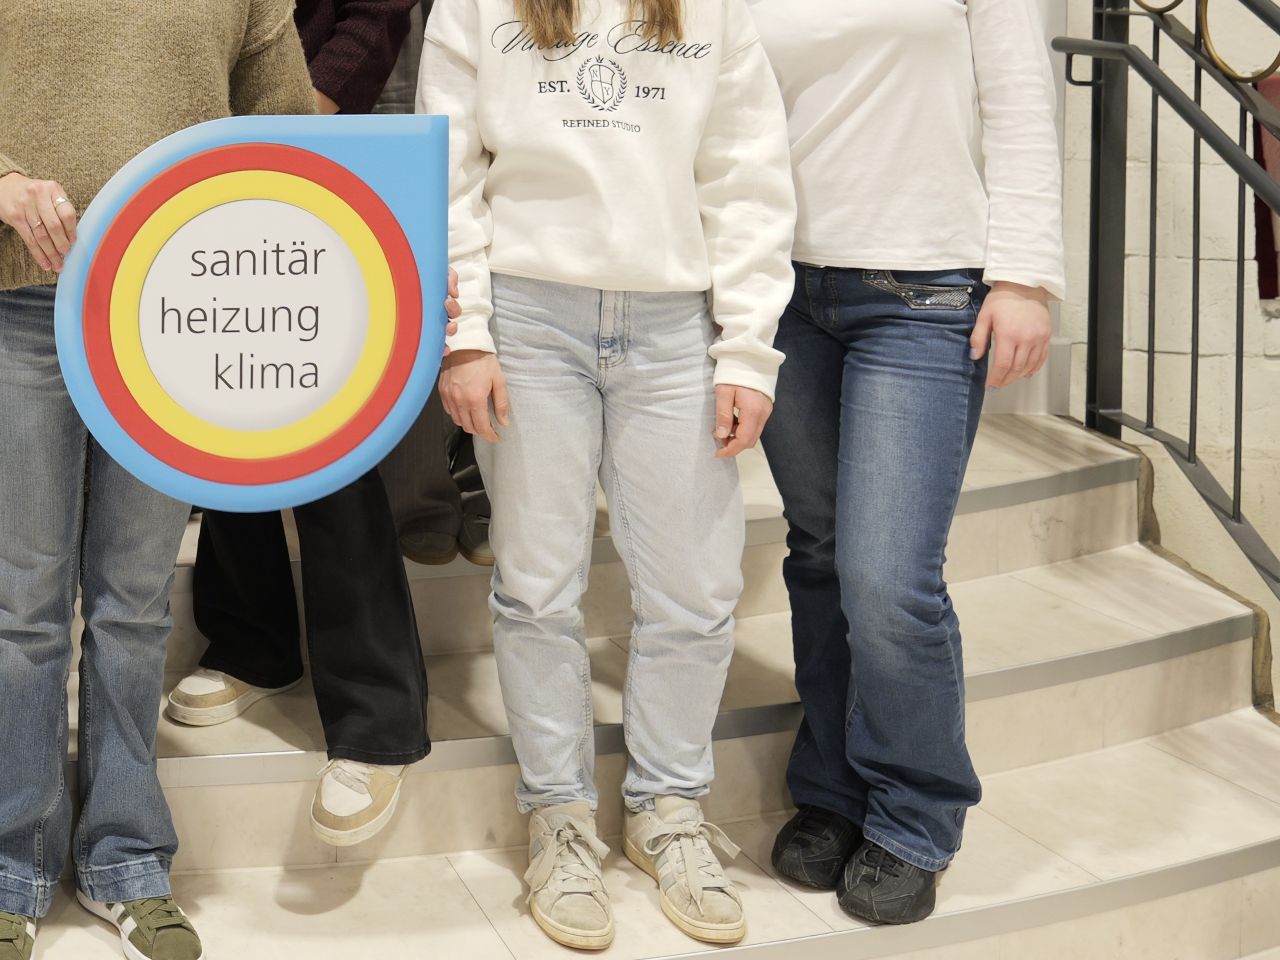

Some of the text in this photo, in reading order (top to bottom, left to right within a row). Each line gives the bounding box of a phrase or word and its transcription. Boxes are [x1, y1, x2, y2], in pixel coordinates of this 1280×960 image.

[538, 80, 666, 100] EST. 1971
[562, 119, 641, 133] REFINED STUDIO
[191, 239, 326, 277] sanitär
[161, 297, 319, 342] heizung
[215, 353, 319, 390] klima
